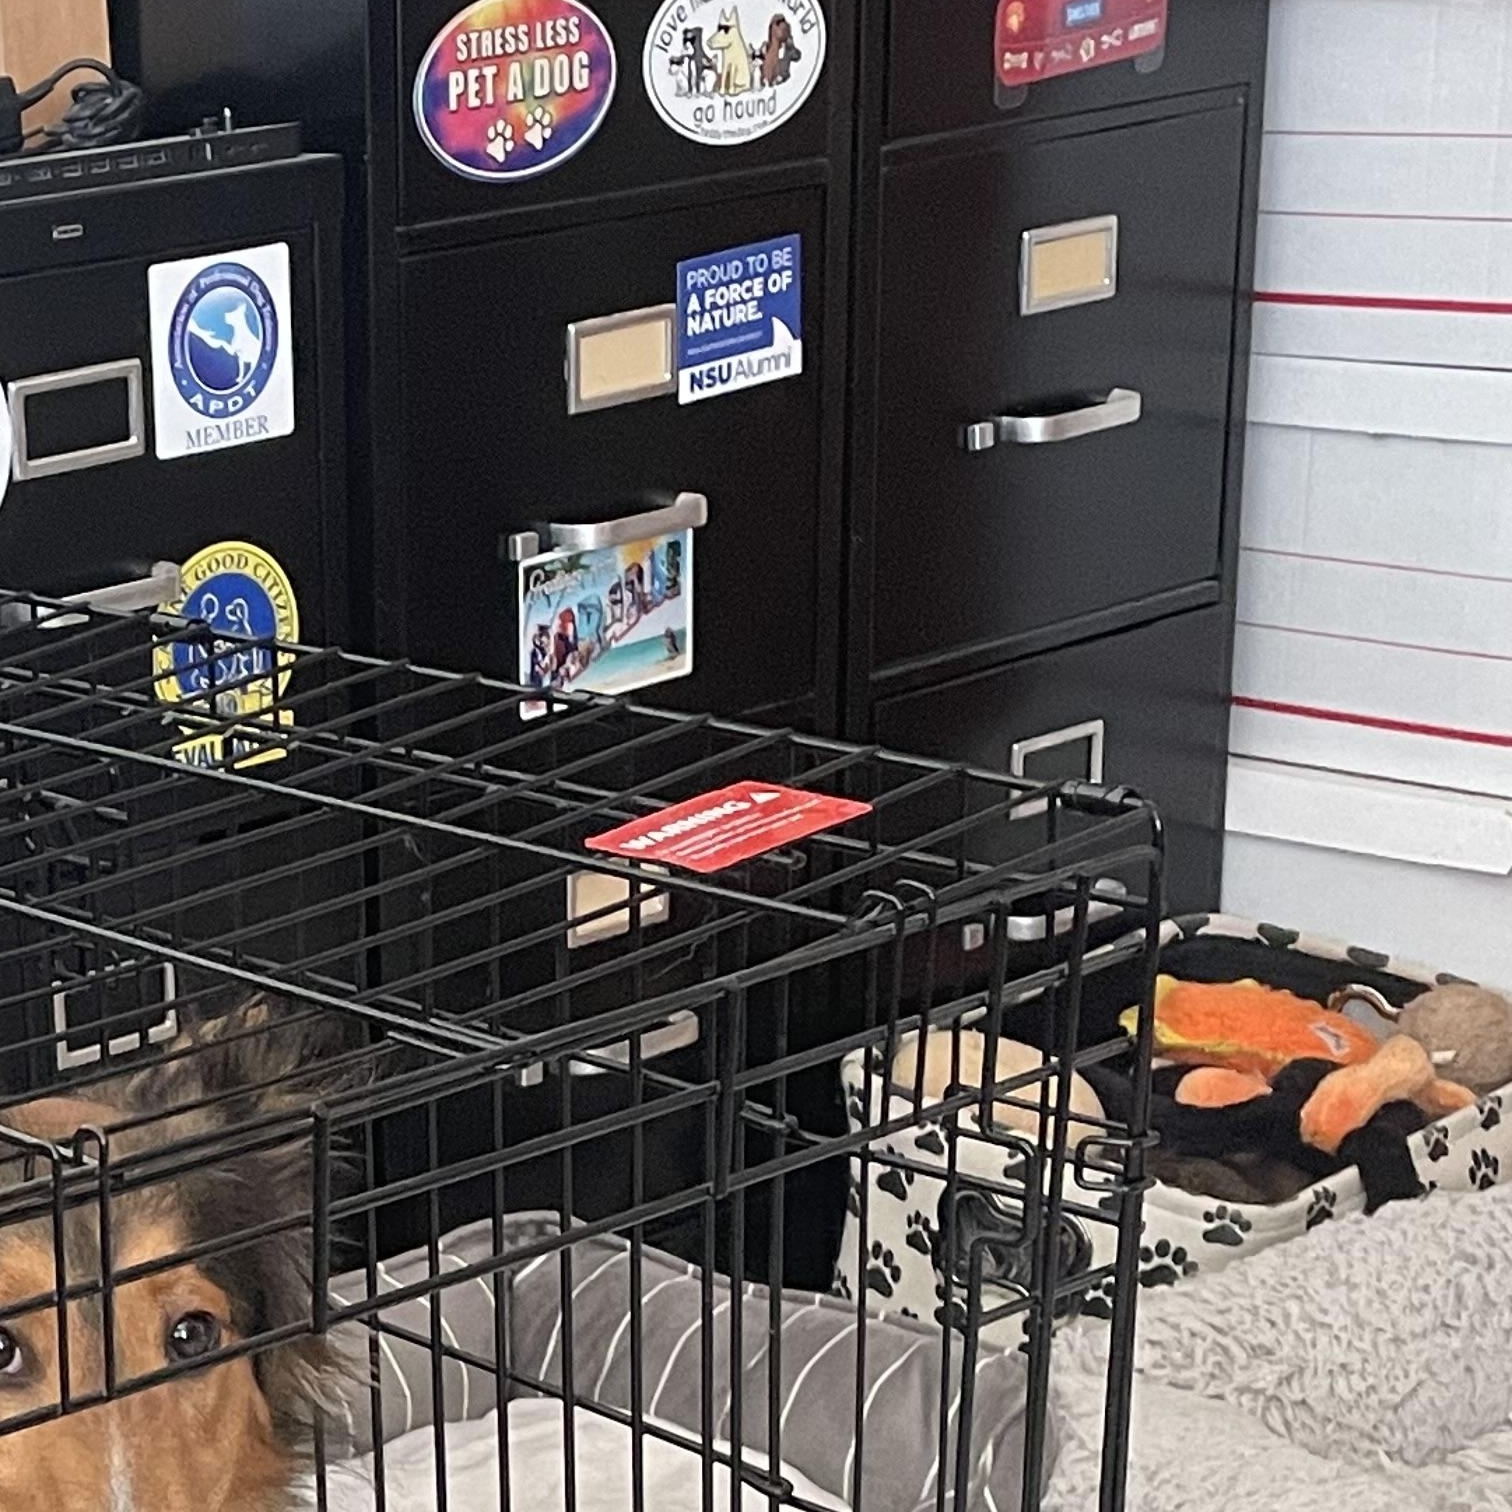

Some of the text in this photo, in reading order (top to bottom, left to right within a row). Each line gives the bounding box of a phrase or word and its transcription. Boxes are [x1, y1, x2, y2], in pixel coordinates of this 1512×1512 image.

[456, 16, 580, 62] STRESS LESS
[655, 4, 688, 53] love
[448, 51, 590, 112] PET A DOG
[693, 90, 777, 129] go hound
[686, 246, 793, 290] PROUD TO BE
[686, 270, 793, 315] A FORCE OF
[189, 380, 257, 416] APDT
[185, 414, 270, 450] MEMBER
[193, 553, 249, 582] GOOD
